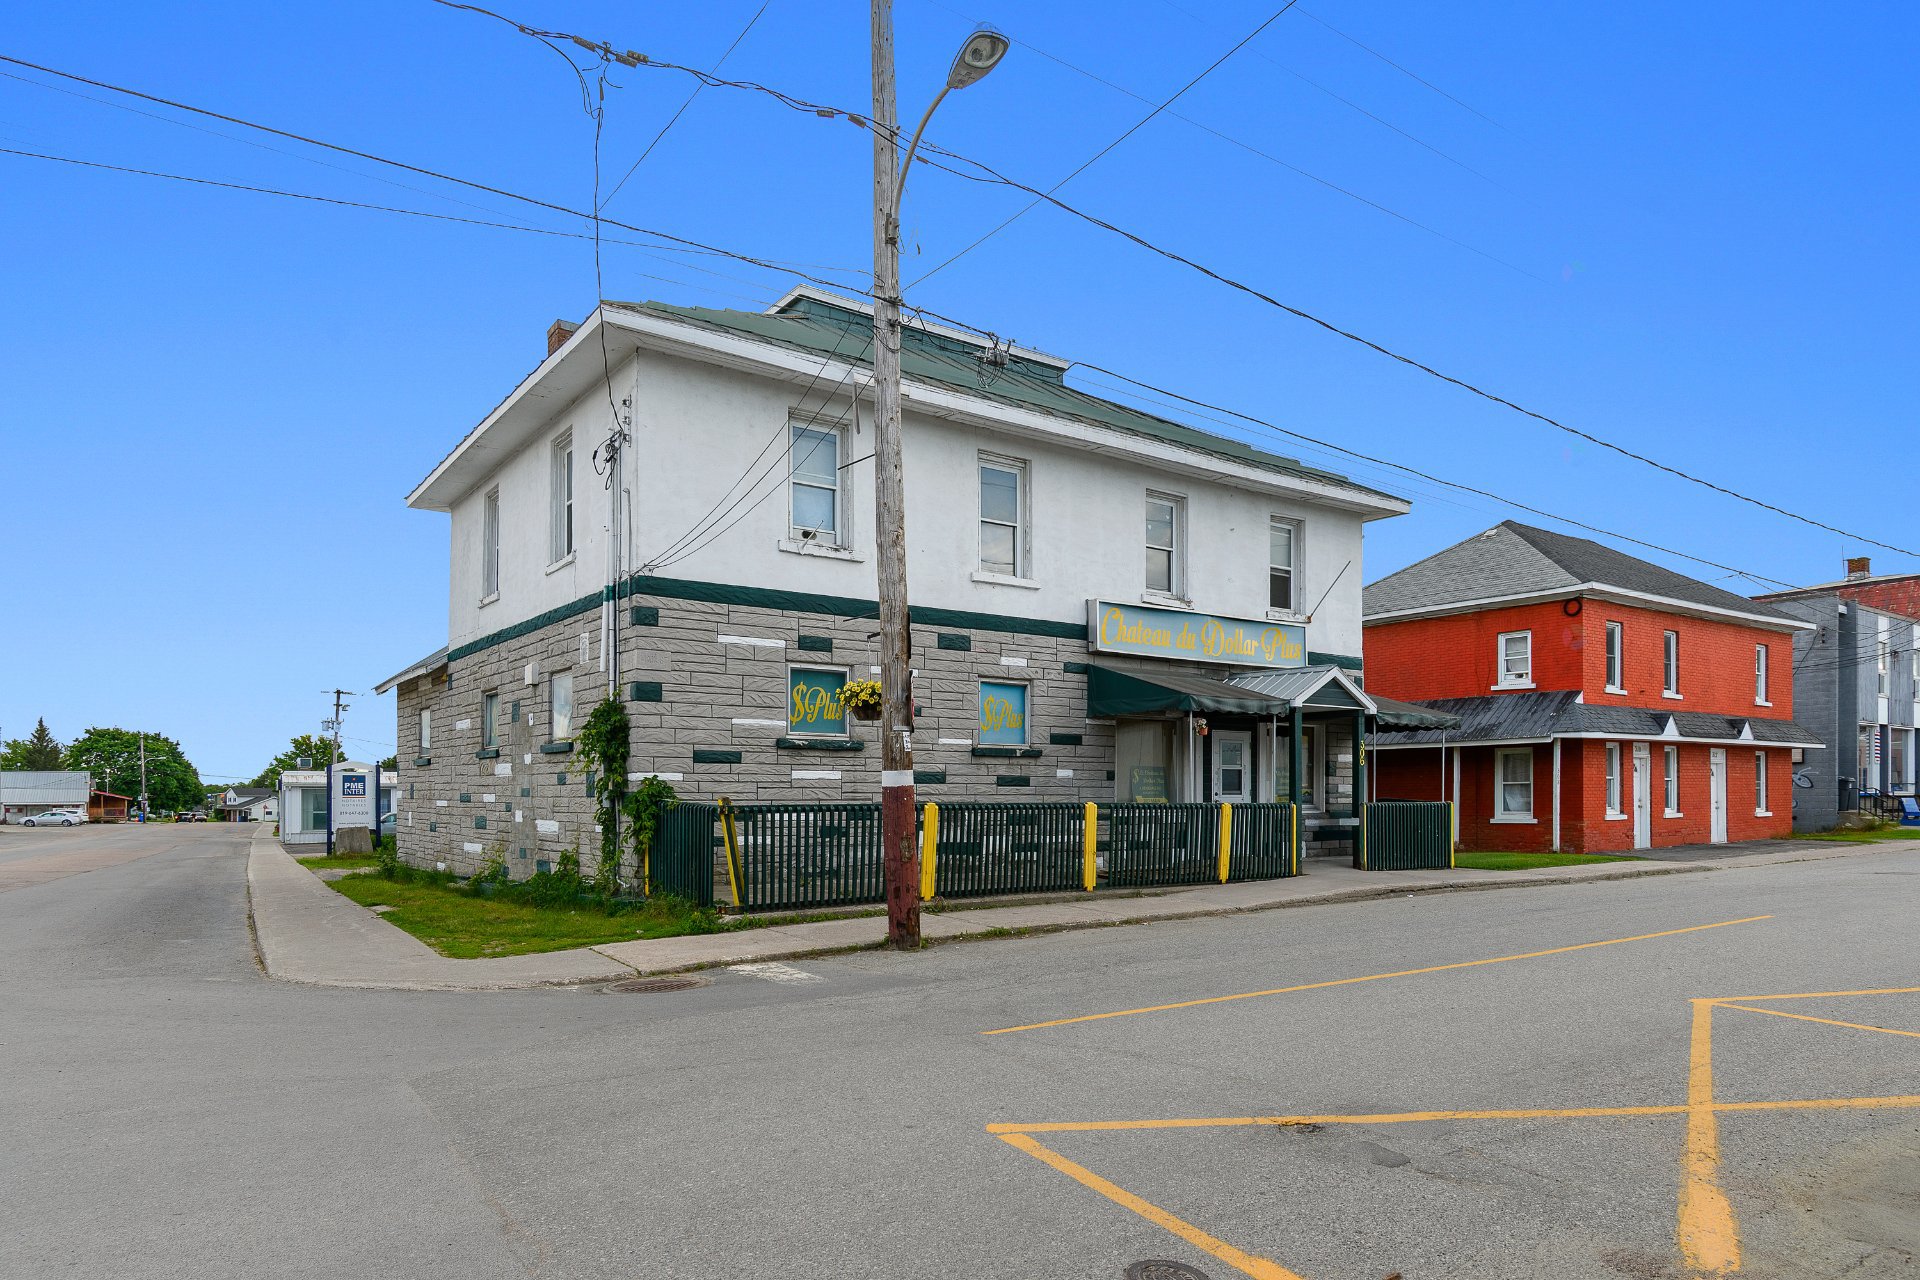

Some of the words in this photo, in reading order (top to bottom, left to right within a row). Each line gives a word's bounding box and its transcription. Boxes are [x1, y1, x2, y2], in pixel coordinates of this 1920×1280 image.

[1101, 607, 1171, 648] Chateau
[1176, 622, 1196, 650] du
[1201, 619, 1259, 657] Dollar
[1261, 627, 1302, 662] Plus
